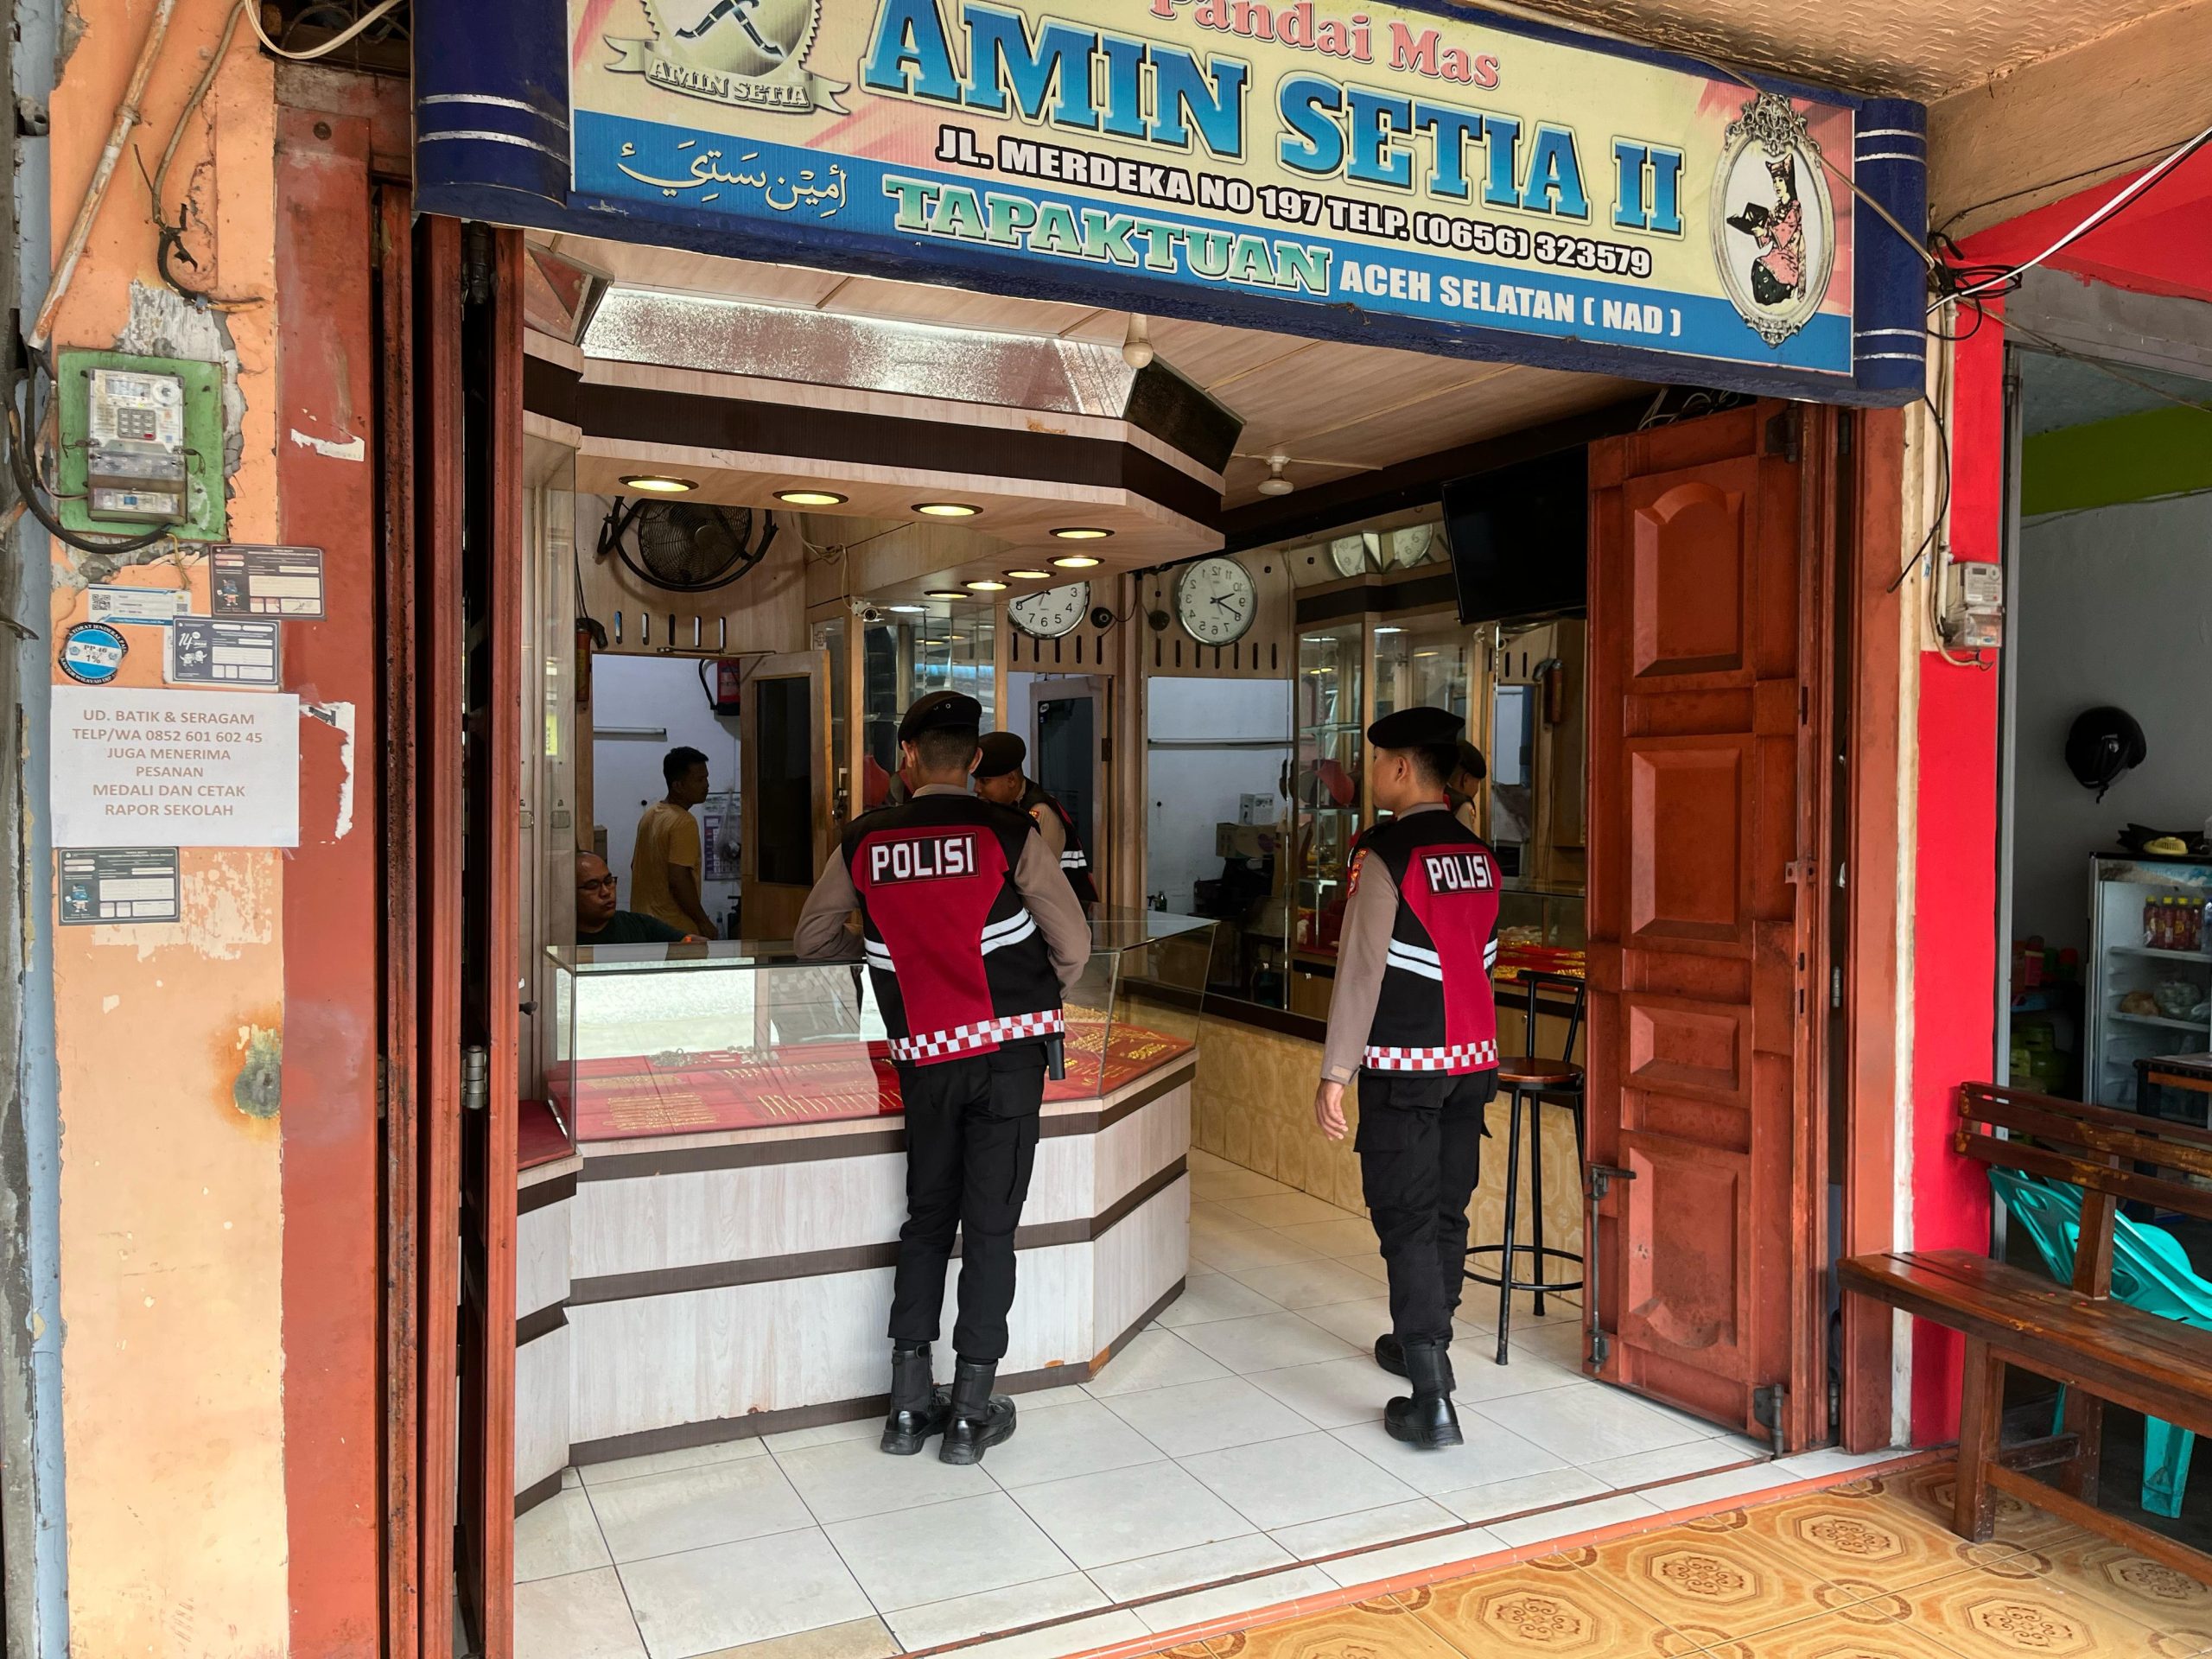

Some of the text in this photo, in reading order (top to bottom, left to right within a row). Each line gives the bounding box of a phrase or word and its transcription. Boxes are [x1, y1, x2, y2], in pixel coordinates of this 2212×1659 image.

[1387, 22, 1499, 88] Mas
[649, 59, 810, 107] AMIN SETIA
[862, 0, 1684, 237] AMIN SETIA II
[938, 128, 1651, 276] JL. MERDEKA NO 197 TELP. (0656) 323579
[883, 175, 1332, 296] TAPAKTUAN
[1339, 261, 1431, 302] ACEH
[1440, 278, 1575, 323] SELATAN
[1603, 300, 1662, 334] NAD
[1071, 587, 1077, 597] 3
[1065, 602, 1072, 613] 4
[1028, 613, 1035, 623] 7
[1040, 617, 1048, 627] 6
[1054, 613, 1062, 624] 5
[86, 654, 101, 664] 1%
[83, 709, 255, 725] UD. BATIK & SERAGAM
[72, 728, 263, 744] TELP/WA 0852 601 602 45
[107, 747, 232, 760] JUGA MENERIMA
[136, 766, 204, 778] PESANAN
[92, 784, 245, 798] MEDALI DAN CETAK
[105, 804, 233, 817] RAPOR SEKOLAH
[871, 836, 975, 882] POLISI
[1426, 855, 1494, 893] POLISI
